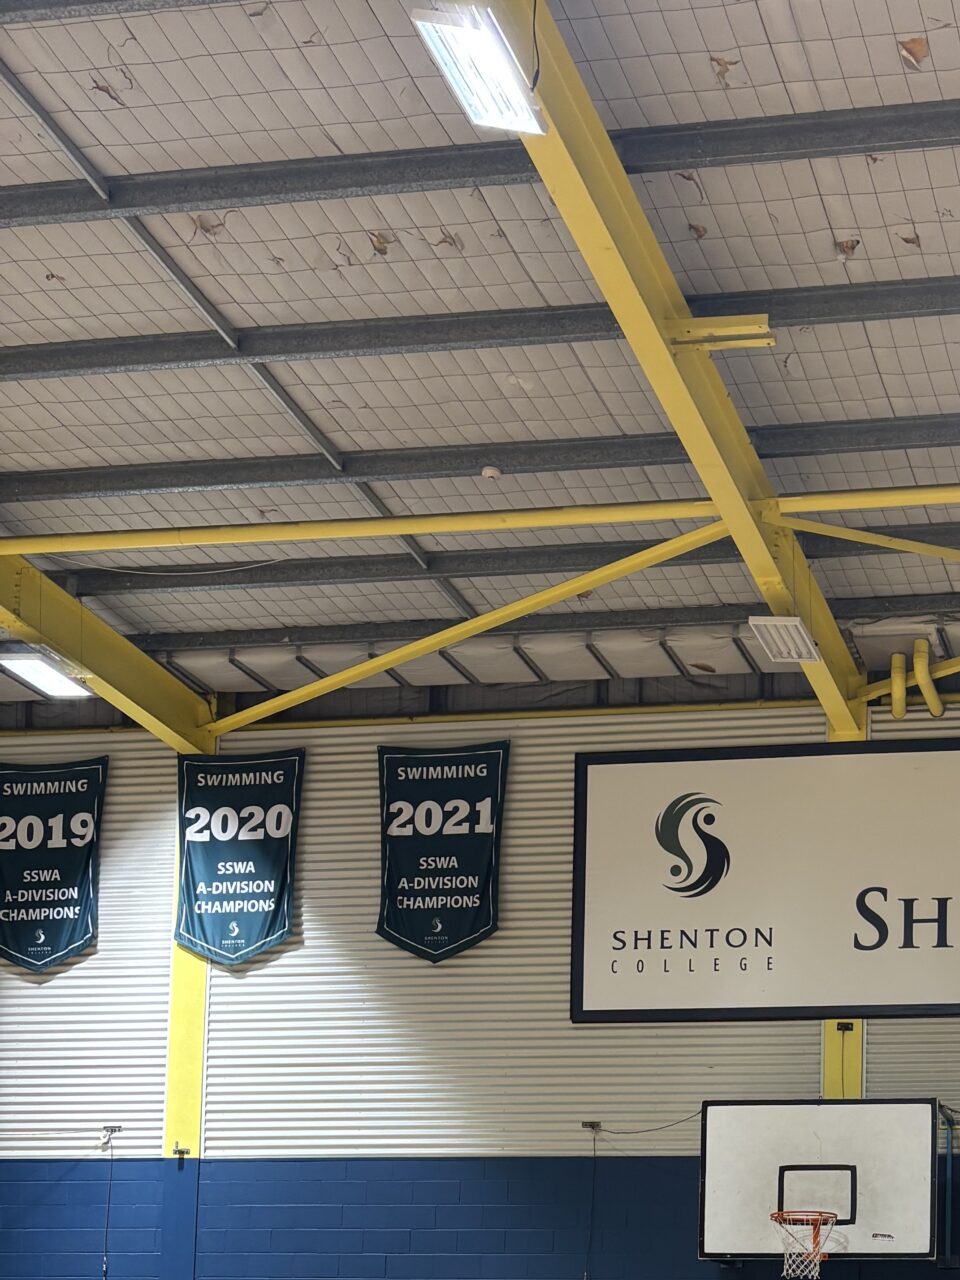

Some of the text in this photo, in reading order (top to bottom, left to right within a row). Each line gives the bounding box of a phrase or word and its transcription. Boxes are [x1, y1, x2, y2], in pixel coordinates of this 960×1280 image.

[197, 771, 284, 786] SWIMMING
[397, 764, 487, 780] SWIMMING
[3, 779, 88, 795] SWIMMING
[185, 804, 293, 841] 2020
[387, 797, 494, 836] 2021
[0, 812, 94, 849] 2019
[217, 861, 256, 874] SSWA
[419, 856, 458, 870] SSWA
[23, 869, 61, 882] SSWA
[398, 876, 479, 890] A-DIVISION
[5, 887, 79, 903] A-DIVISION
[196, 880, 275, 895] A-DIVISION
[195, 899, 275, 914] CHAMPIONS
[397, 895, 480, 910] CHAMPIONS
[0, 906, 81, 922] CHAMPIONS
[612, 927, 773, 951] SHENTON
[611, 957, 773, 974] COLLEGE
